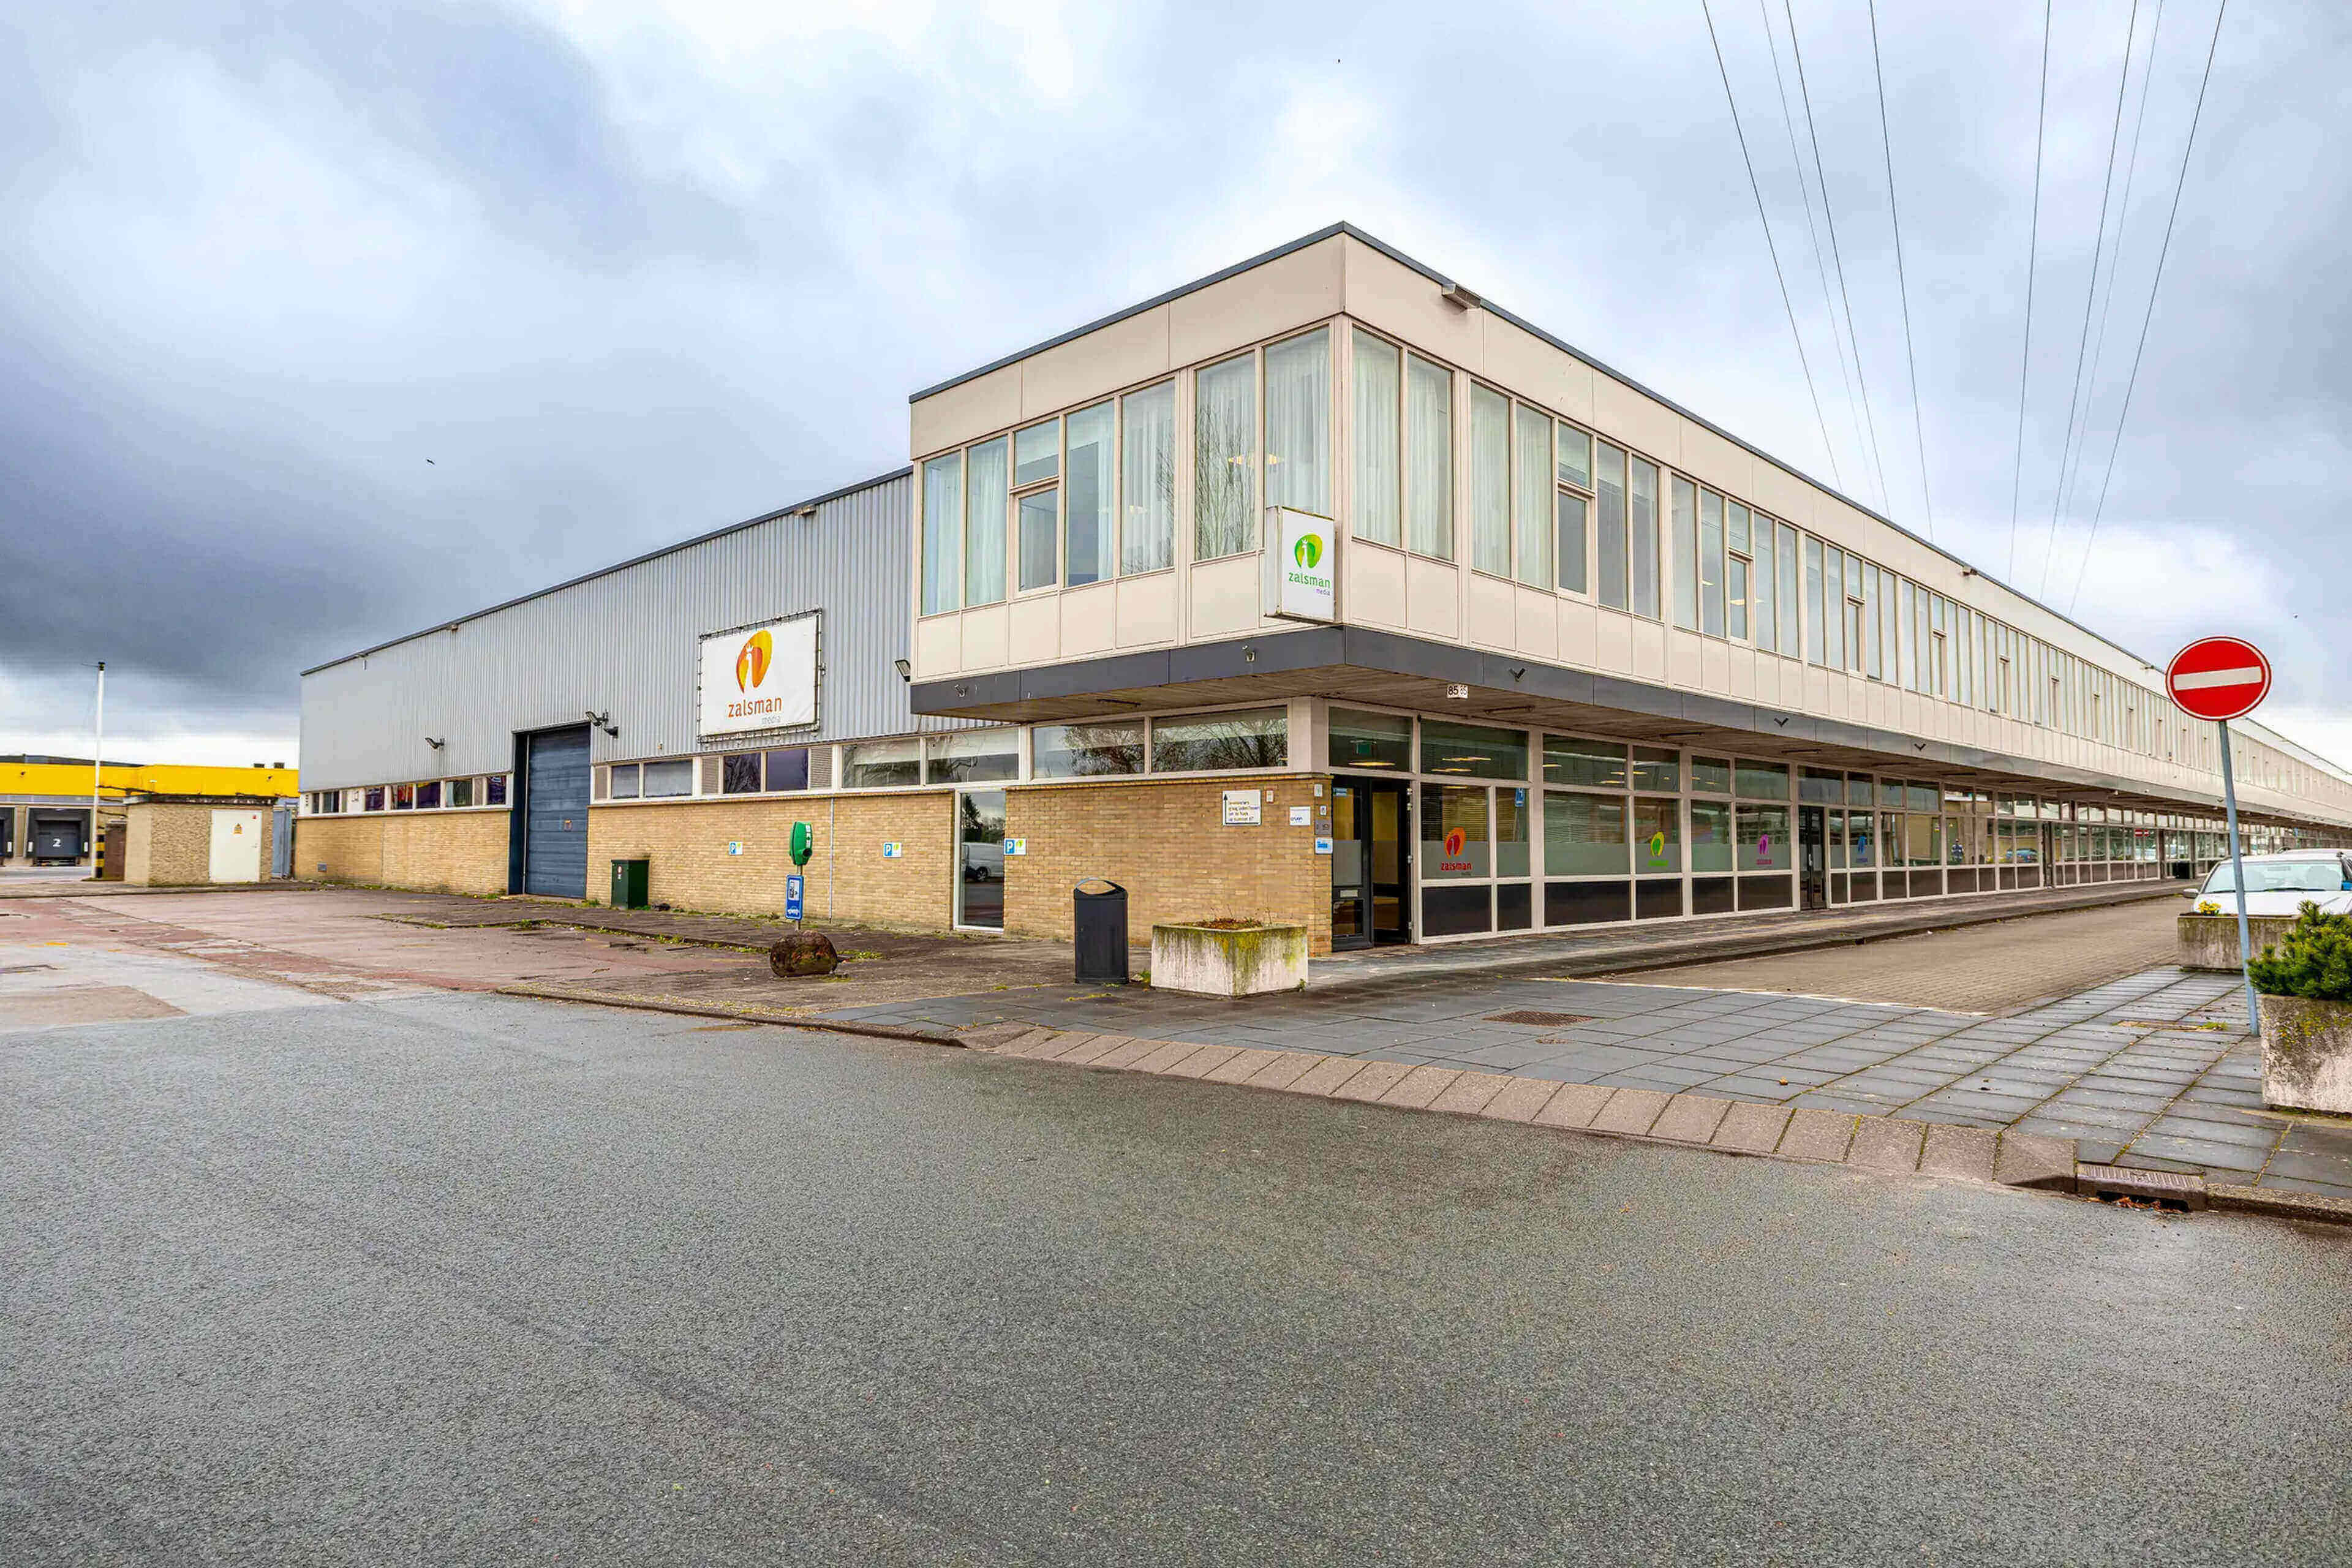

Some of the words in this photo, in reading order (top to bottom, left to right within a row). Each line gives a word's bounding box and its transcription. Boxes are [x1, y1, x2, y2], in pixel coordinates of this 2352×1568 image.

[1288, 572, 1330, 589] zalsman
[1448, 685, 1458, 695] 85
[728, 697, 782, 718] zalsman
[53, 839, 61, 847] 2
[1006, 841, 1013, 853] P
